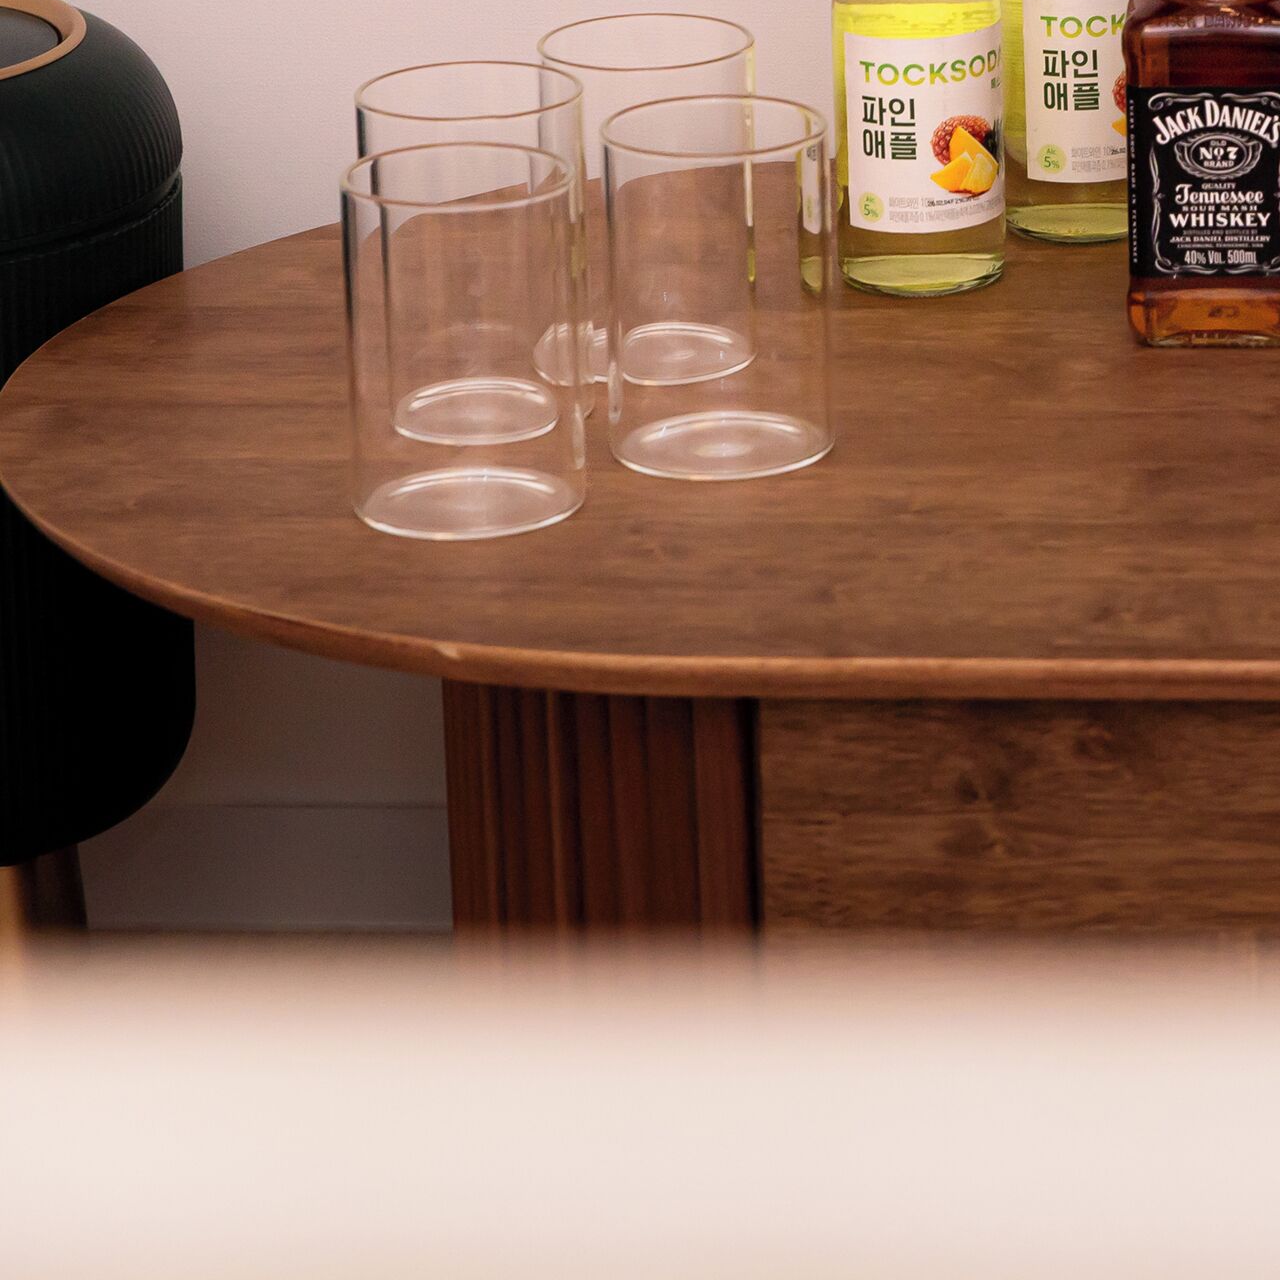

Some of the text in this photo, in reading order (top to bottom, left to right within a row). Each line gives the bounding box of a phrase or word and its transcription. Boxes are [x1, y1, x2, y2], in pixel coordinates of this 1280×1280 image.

[1040, 12, 1126, 39] TOCK
[1043, 49, 1098, 78] 파인
[1043, 81, 1100, 111] 애플
[862, 95, 916, 127] 파인
[1152, 106, 1204, 145] JACK
[863, 129, 917, 160] 애플
[1044, 156, 1060, 168] 5%
[1203, 161, 1235, 169] BRAND
[1175, 183, 1264, 205] Tennessee
[863, 204, 879, 218] 5%
[1169, 212, 1271, 228] WHISKEY
[1184, 250, 1207, 265] 40%
